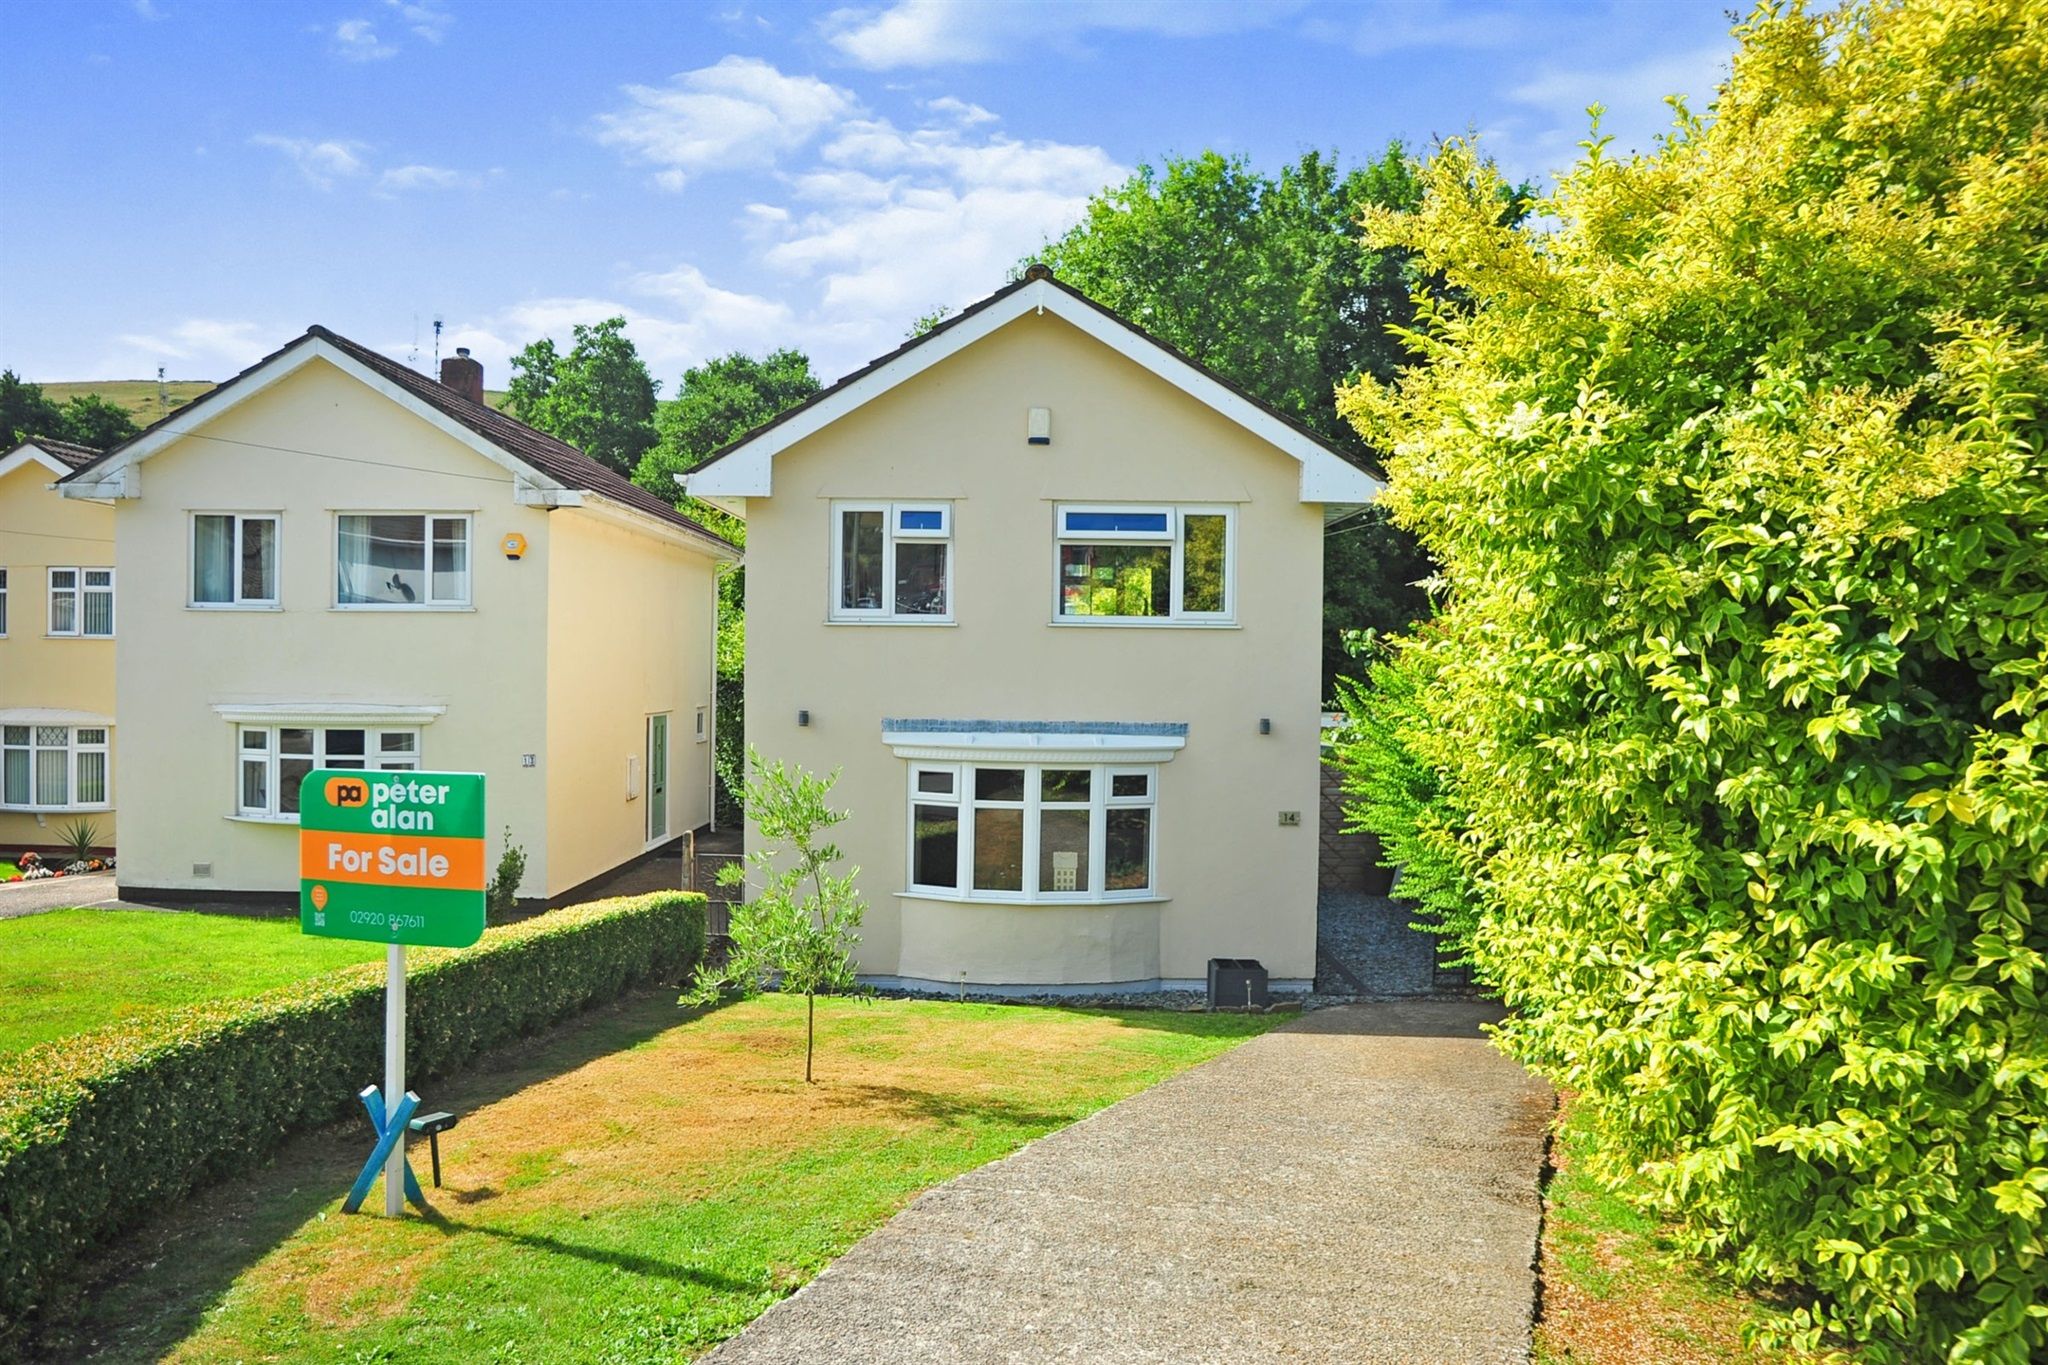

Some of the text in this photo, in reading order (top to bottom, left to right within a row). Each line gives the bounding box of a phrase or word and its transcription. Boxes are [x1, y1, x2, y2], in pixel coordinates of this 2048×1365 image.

[337, 784, 362, 807] pa
[372, 780, 450, 808] peter
[371, 804, 434, 830] alan
[1284, 813, 1295, 822] 14
[328, 843, 449, 878] For Sale
[350, 911, 425, 928] 02920 867611
